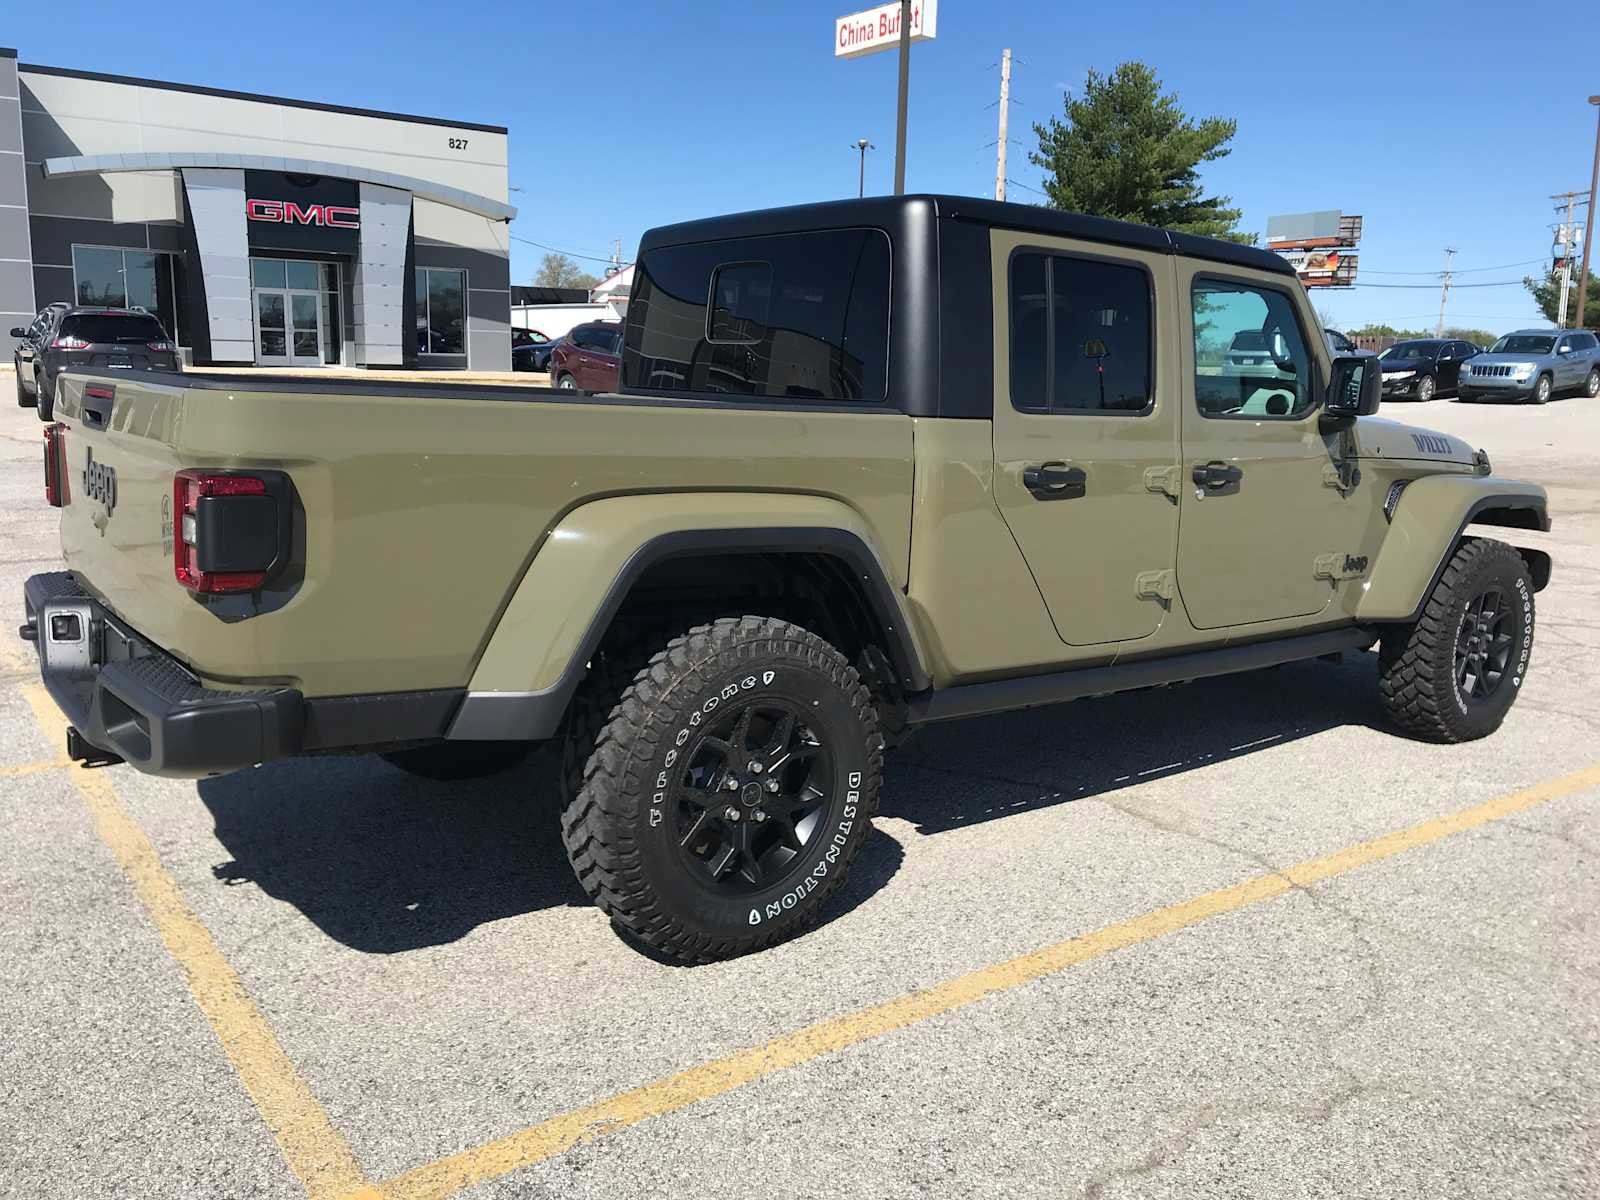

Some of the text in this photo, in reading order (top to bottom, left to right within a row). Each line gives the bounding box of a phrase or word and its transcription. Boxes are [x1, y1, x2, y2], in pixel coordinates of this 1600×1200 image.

[840, 6, 919, 47] China Bufet
[449, 138, 468, 150] 827
[247, 198, 360, 229] GMC
[82, 446, 116, 518] Jeep
[1343, 554, 1368, 573] Jeep
[766, 772, 861, 919] DESTINATION
